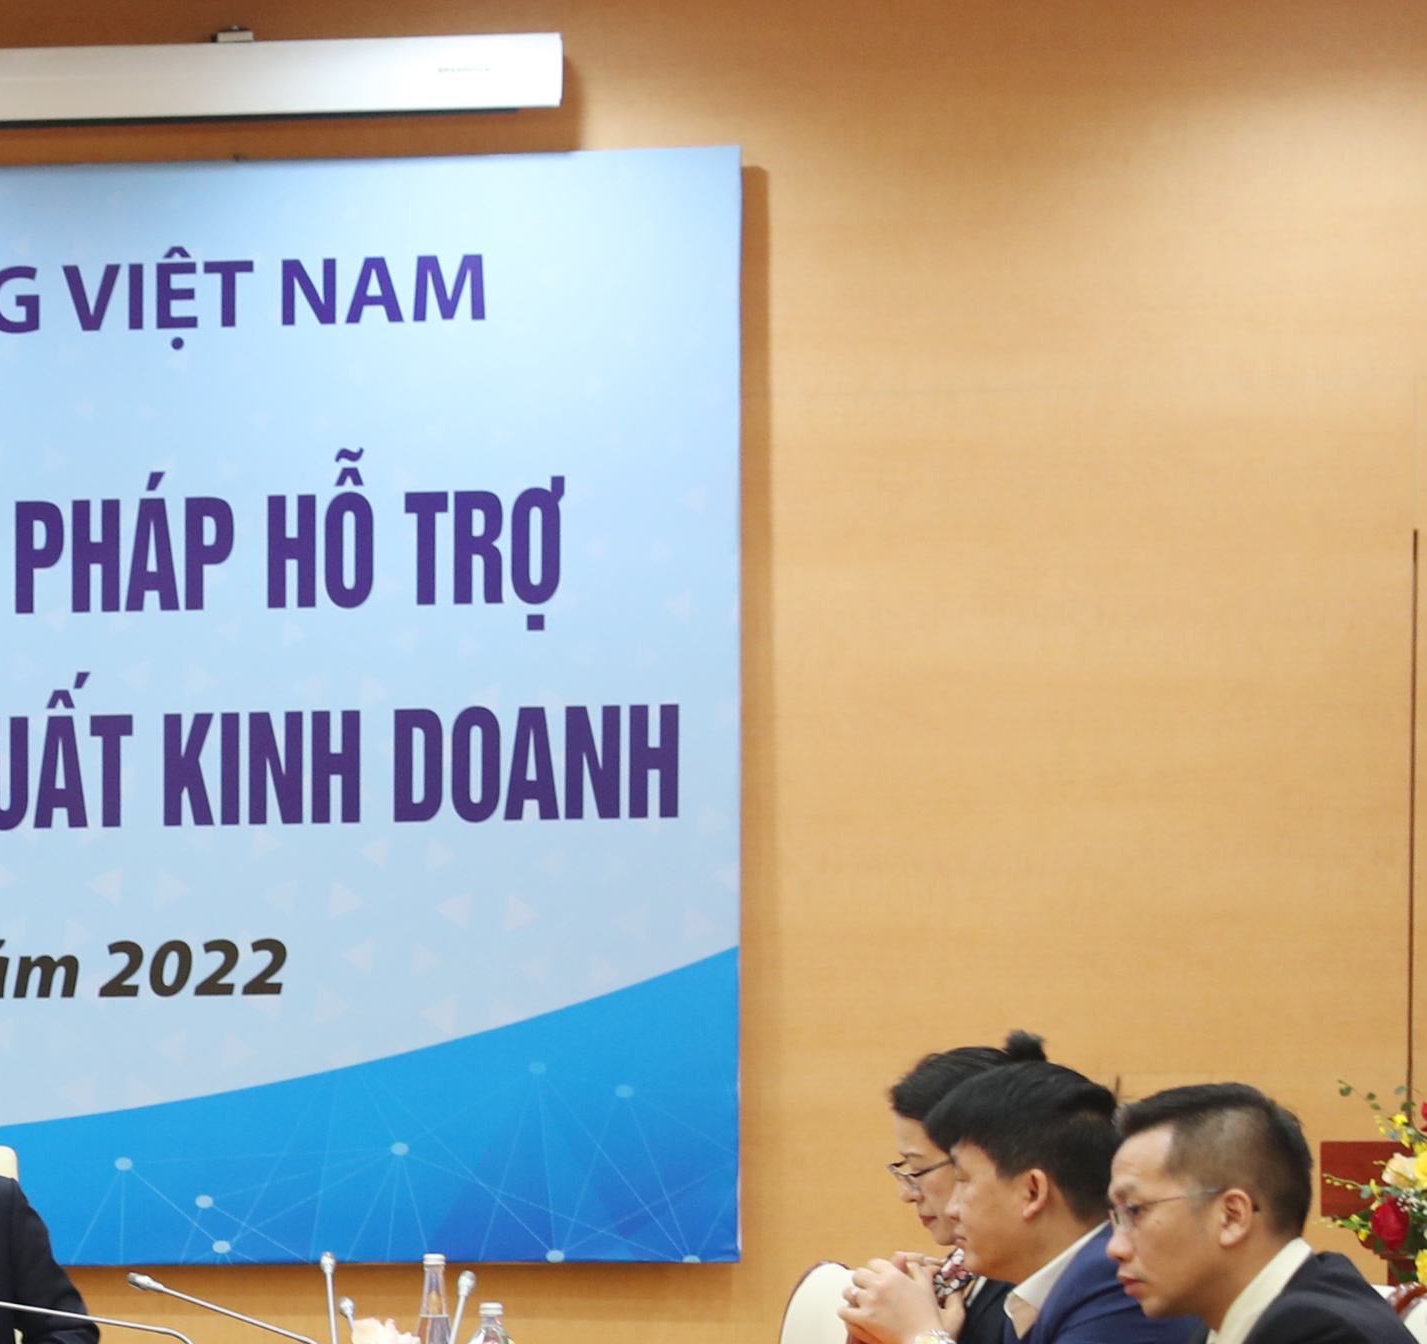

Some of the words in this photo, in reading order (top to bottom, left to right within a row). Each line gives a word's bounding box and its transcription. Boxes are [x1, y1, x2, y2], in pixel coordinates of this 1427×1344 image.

[61, 245, 254, 351] VIỆT
[281, 254, 486, 326] NAM
[14, 471, 235, 615] PHÁP
[267, 447, 374, 609] HỖ
[404, 475, 565, 632] TRỢ
[163, 709, 361, 827] KINH
[393, 703, 680, 824] DOANH
[98, 938, 288, 998] 2022
